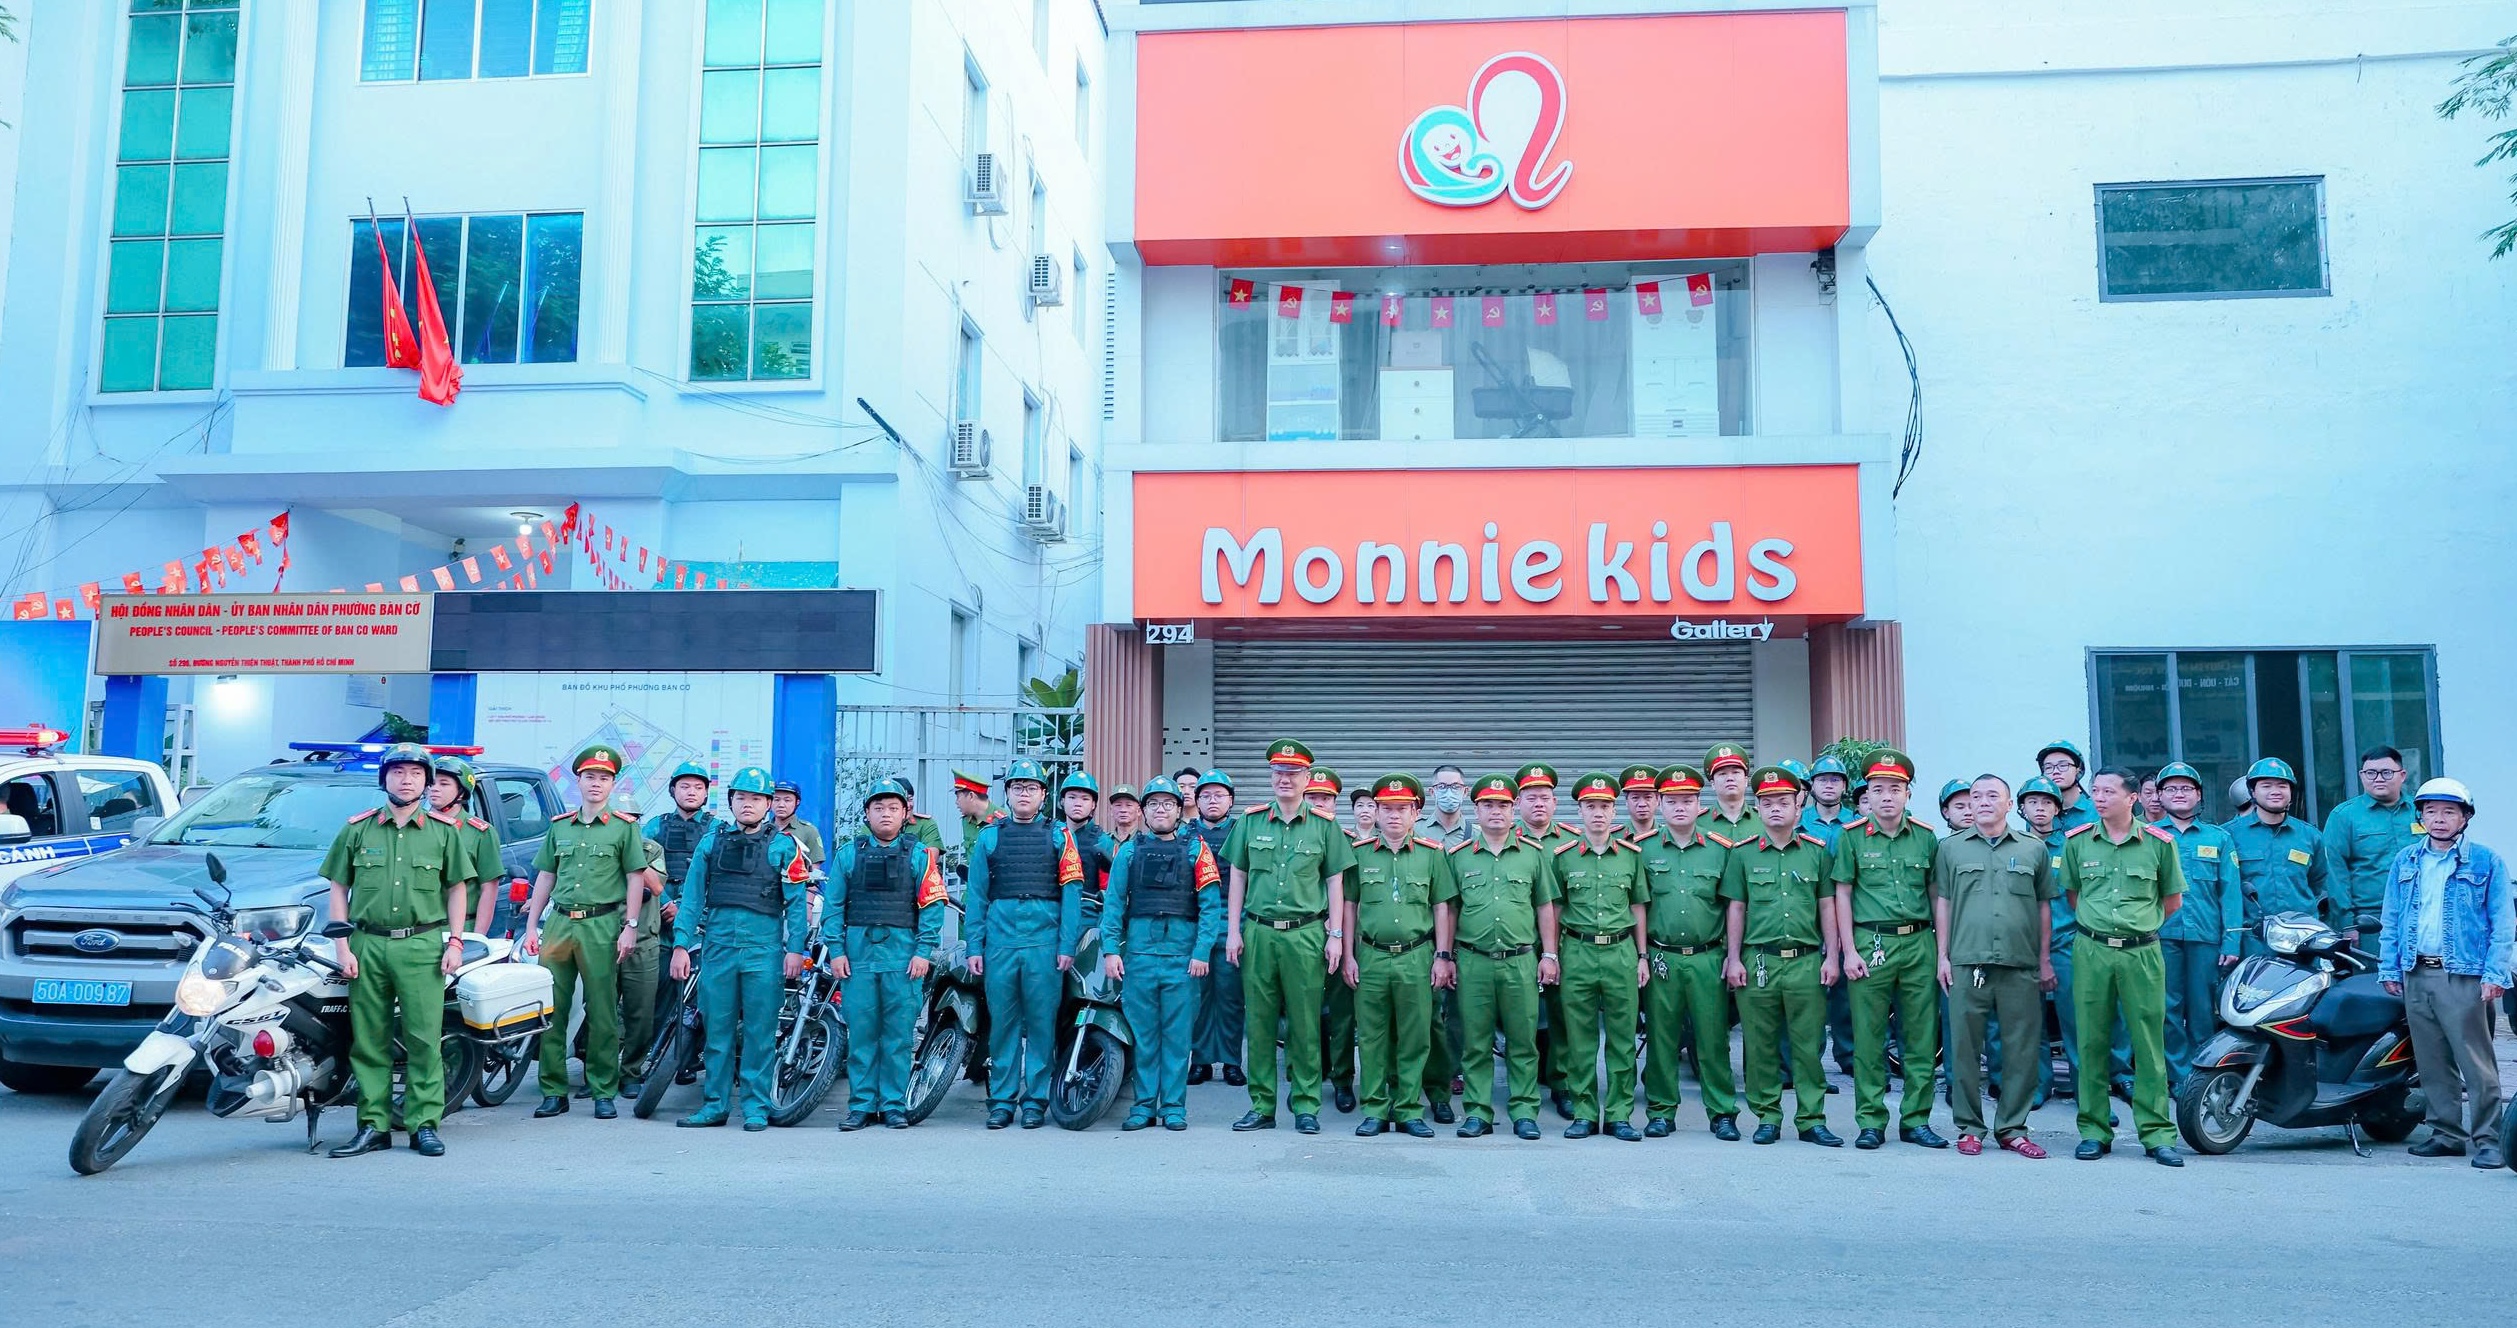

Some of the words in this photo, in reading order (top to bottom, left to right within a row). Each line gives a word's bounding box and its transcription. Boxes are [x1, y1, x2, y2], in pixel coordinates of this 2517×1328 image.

[1201, 521, 1563, 605] Monnie
[1586, 519, 1798, 603] kids
[111, 603, 128, 620] HỘI
[165, 602, 195, 617] NHÂN
[199, 602, 220, 617] DÂN
[231, 601, 245, 617] ỦY
[247, 604, 270, 616] BAN
[273, 602, 304, 616] NHÂN
[306, 602, 329, 616] DÂN
[332, 601, 376, 616] PHƯỜNG
[130, 625, 172, 637] PEOPLE'S
[175, 625, 213, 636] COUNCIL
[222, 625, 264, 636] PEOPLE'S
[267, 625, 319, 636] COMMITTEE
[321, 625, 333, 635] OF
[335, 625, 354, 635] BAN
[356, 625, 368, 635] CO
[371, 625, 398, 635] WARD
[1148, 624, 1192, 644] 294
[1670, 619, 1775, 642] Gallery
[80, 934, 106, 946] Ford
